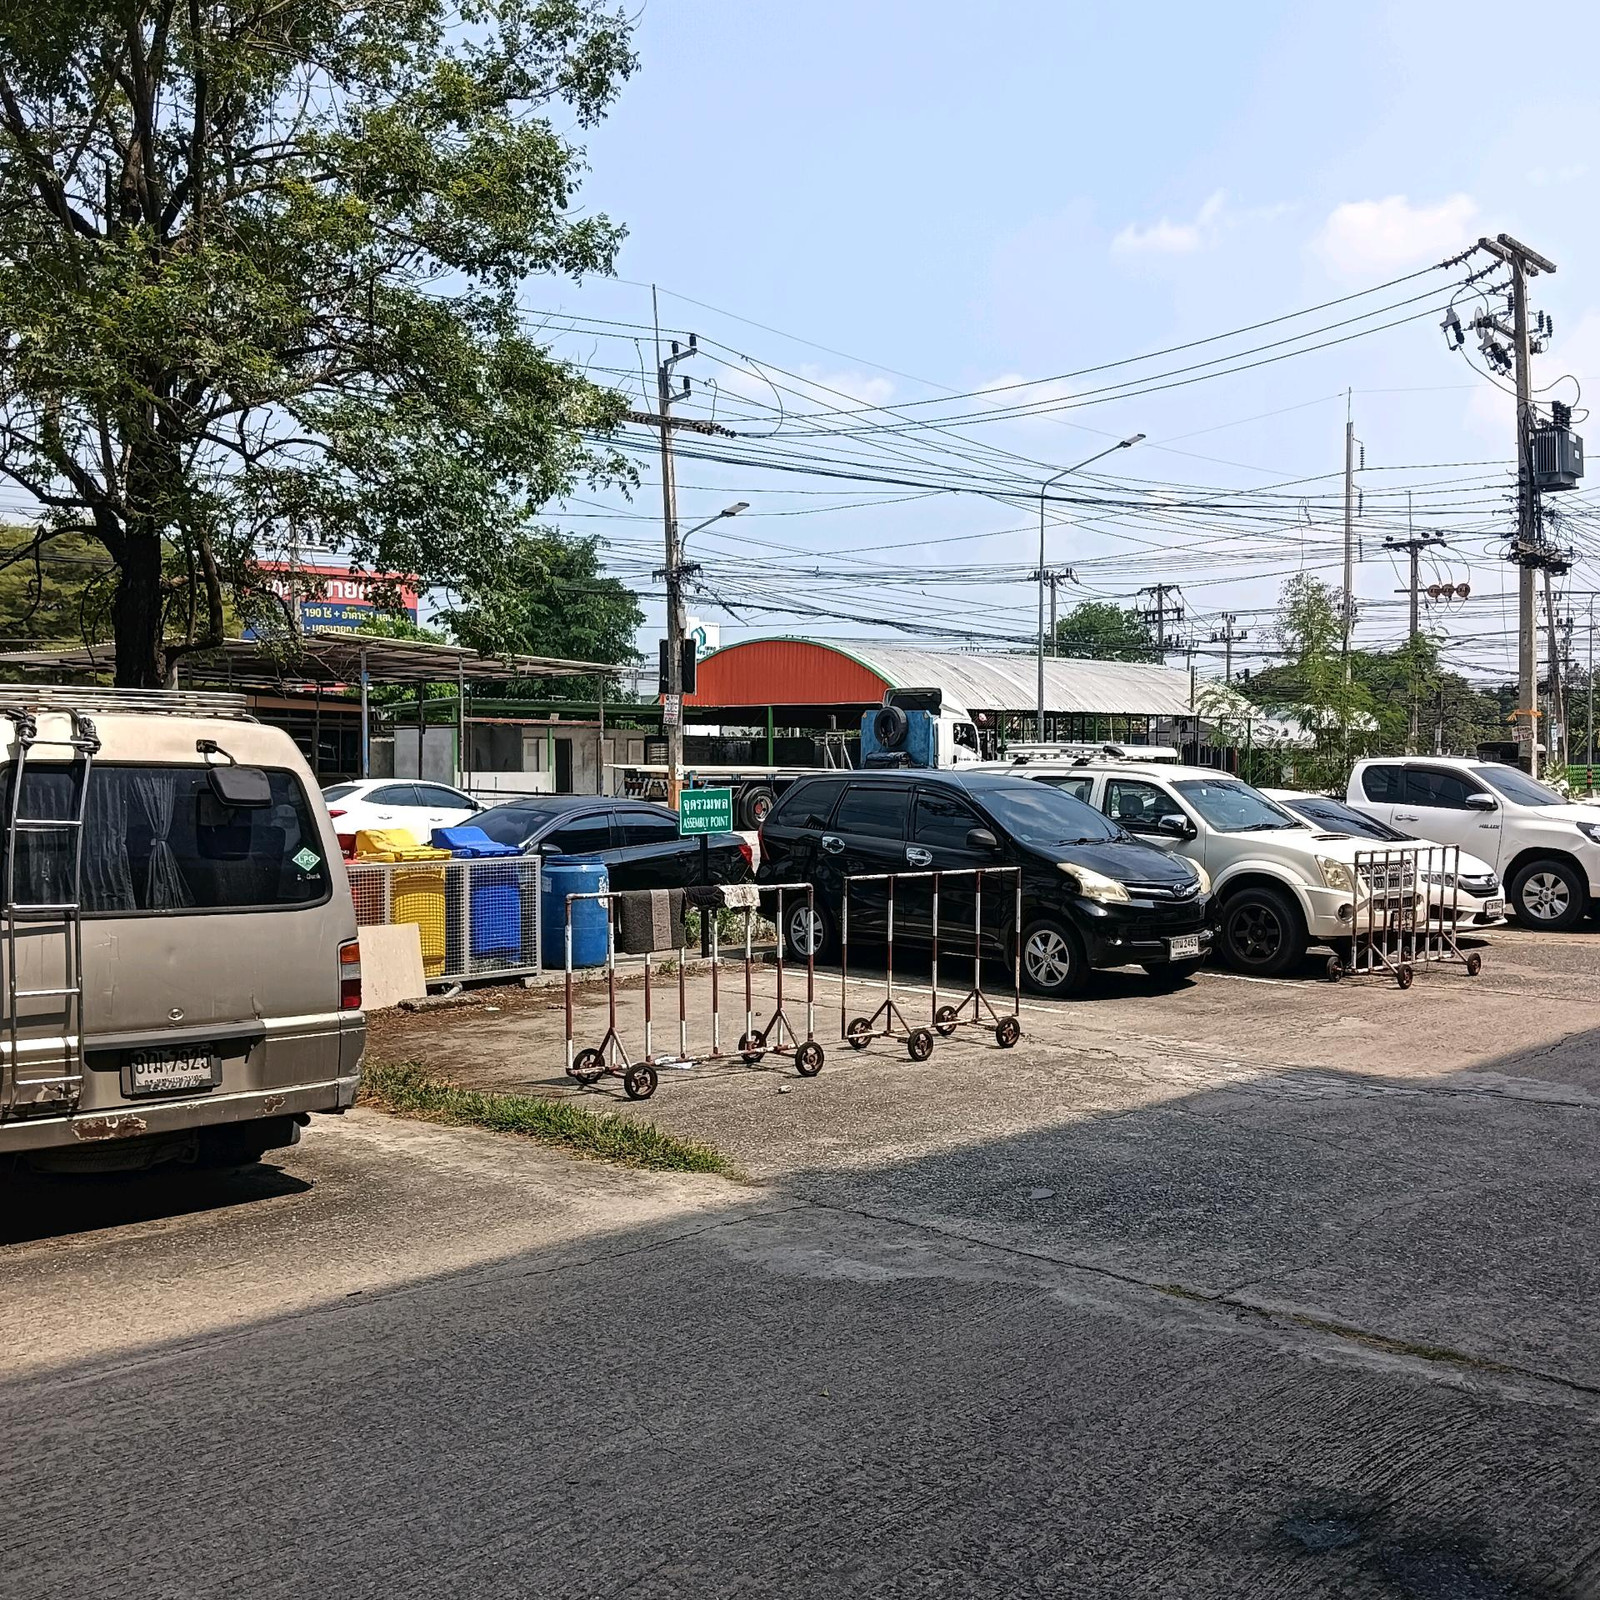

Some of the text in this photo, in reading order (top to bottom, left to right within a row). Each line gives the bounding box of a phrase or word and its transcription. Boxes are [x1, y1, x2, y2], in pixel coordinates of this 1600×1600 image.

[304, 608, 322, 618] 190
[683, 799, 728, 815] จุดรวมพล
[683, 816, 728, 828] ASSEMBLY POINT
[298, 855, 315, 864] LPG
